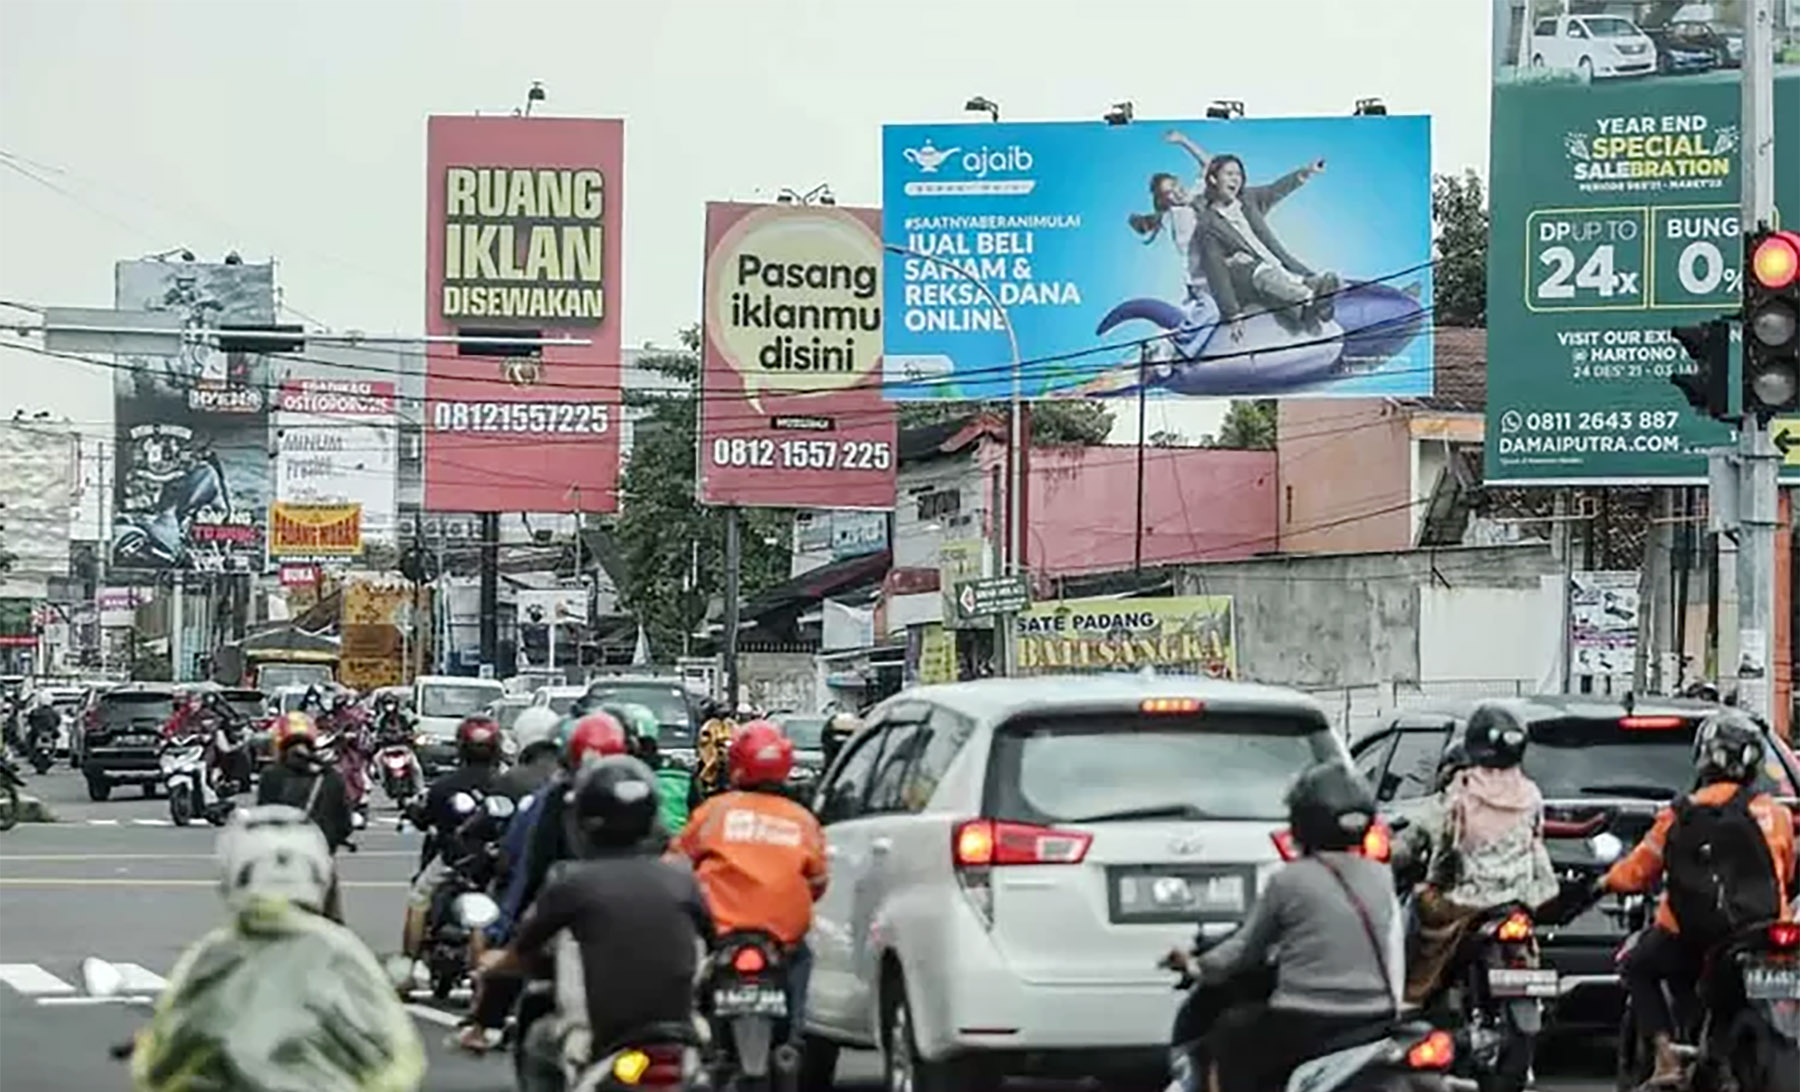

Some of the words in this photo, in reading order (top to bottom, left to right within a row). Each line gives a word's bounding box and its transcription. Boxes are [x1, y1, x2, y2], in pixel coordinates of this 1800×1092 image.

[1597, 117, 1656, 134] YEAR
[1662, 115, 1707, 133] END
[1592, 135, 1711, 159] SPECIAL
[962, 144, 1033, 179] ajaib
[1574, 158, 1730, 180] SALEBRATION
[446, 168, 604, 219] RUANG
[905, 214, 1081, 230] #SAATNYABERANIMULAI
[1540, 222, 1571, 241] DP
[1572, 221, 1602, 241] UP
[1606, 220, 1638, 240] TO
[1667, 217, 1740, 239] BUNG
[445, 224, 603, 282] IKLAN
[977, 231, 1034, 255] BELI
[738, 255, 877, 298] Pasang
[905, 257, 1006, 281] SAHAM
[1012, 258, 1032, 280] &
[443, 286, 604, 318] DISEWAKAN
[905, 284, 992, 306] REKSA
[1001, 282, 1081, 305] DANA
[733, 292, 881, 331] iklanmu
[905, 308, 1007, 331] ONLINE
[1557, 331, 1600, 346] VISIT
[1603, 330, 1640, 345] OUR
[759, 334, 854, 373] disini
[1591, 347, 1676, 362] HARTONO
[434, 402, 609, 434] 08121557225
[1527, 411, 1571, 431] 0811
[1578, 411, 1632, 430] 2643
[1639, 410, 1680, 429] 887
[714, 438, 774, 466] 0812
[779, 440, 838, 468] 1557
[842, 441, 890, 470] 225
[1499, 434, 1680, 454] DAMAIPUTRA.COM
[1016, 615, 1066, 632] SATE
[1072, 612, 1154, 630] PADANG
